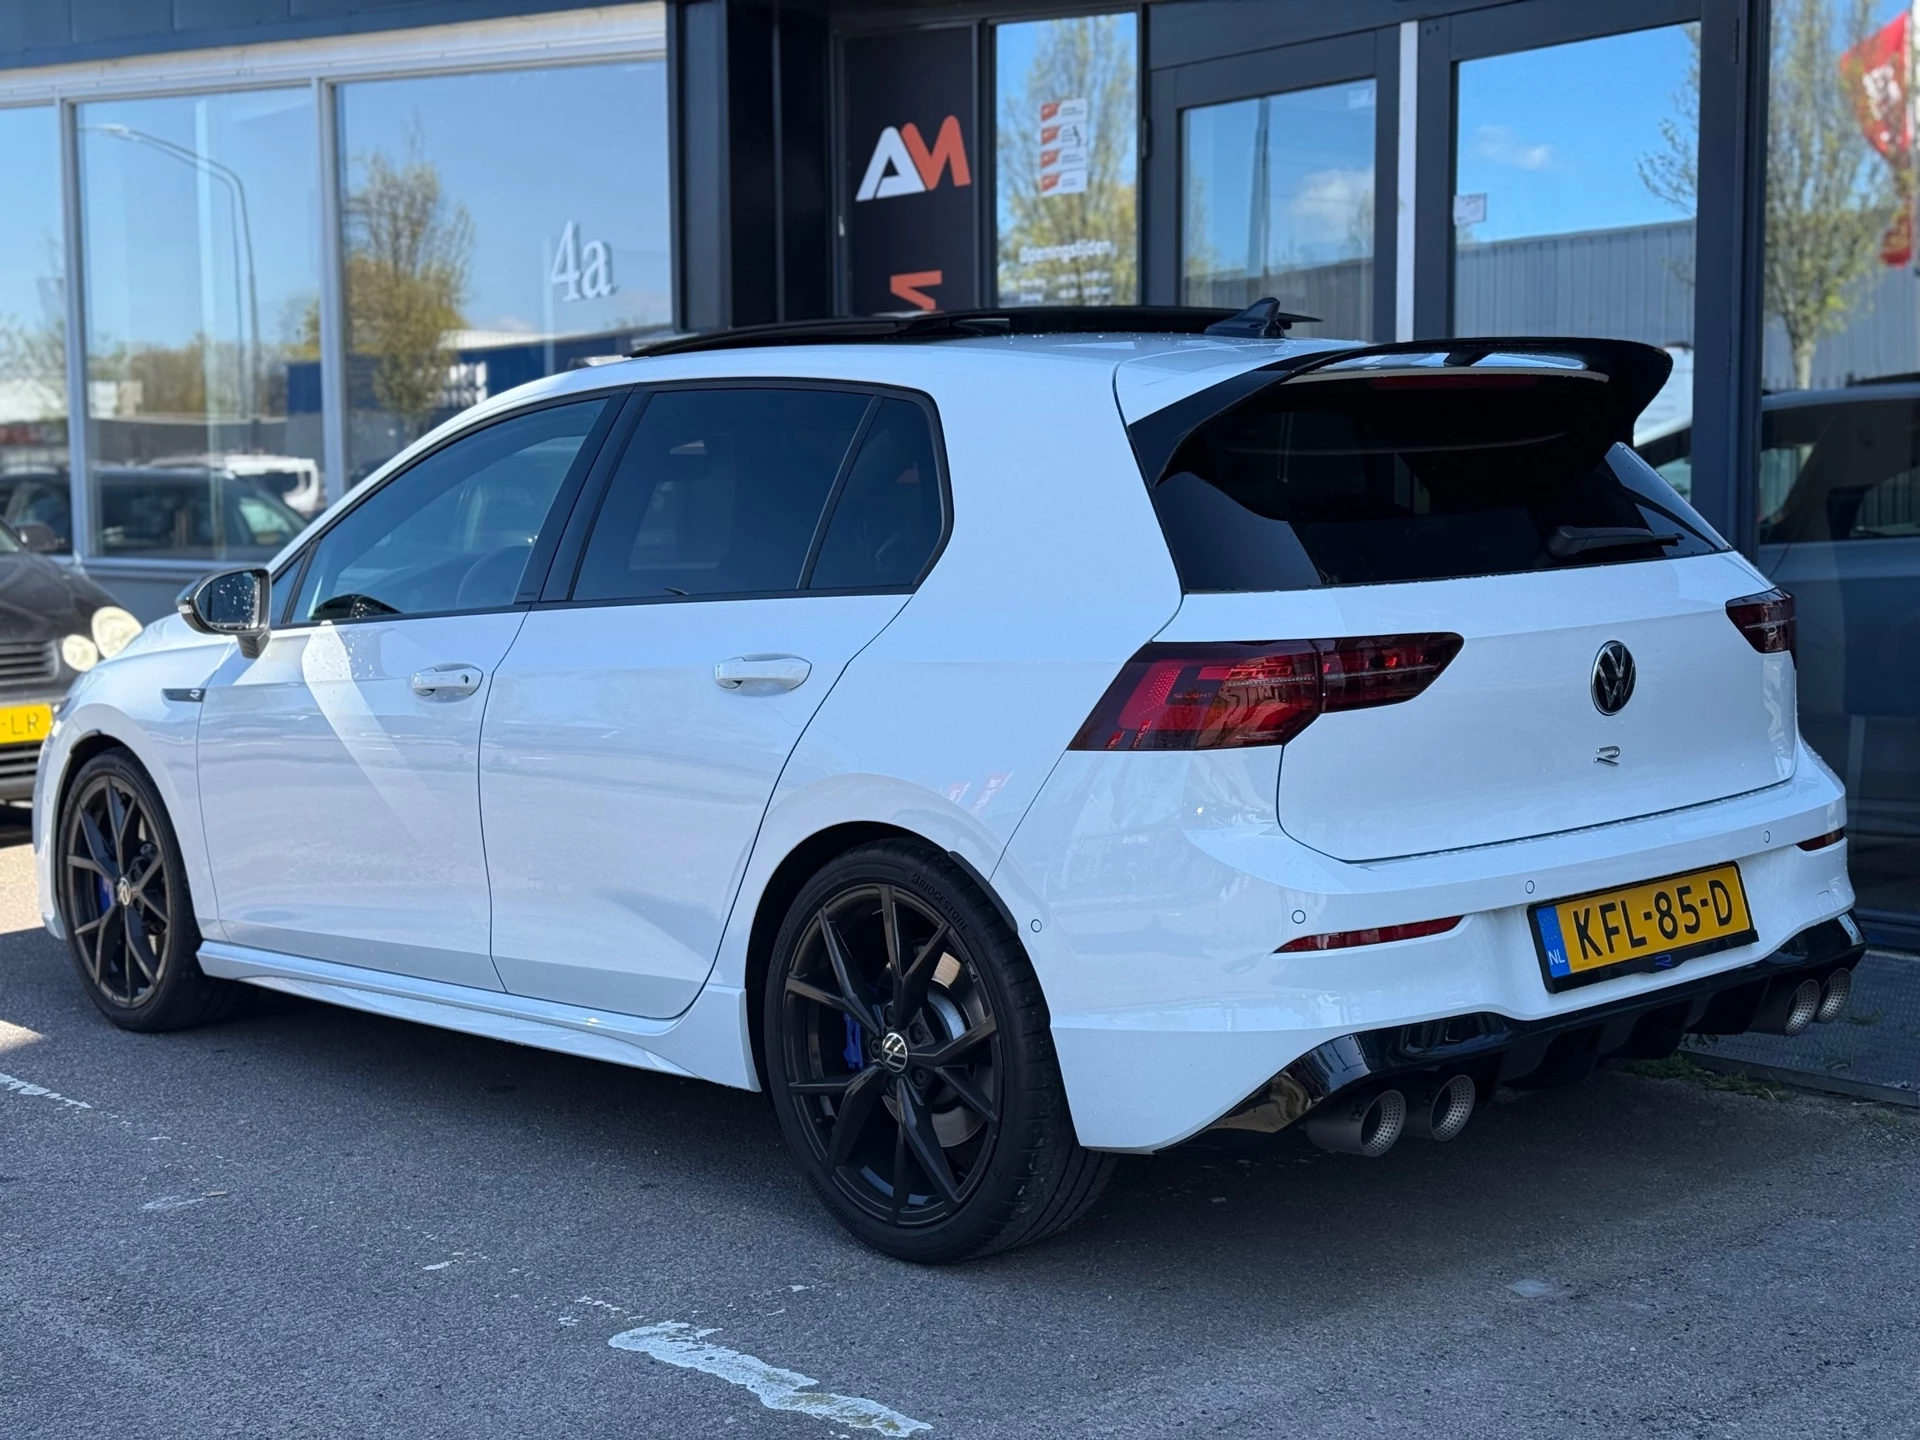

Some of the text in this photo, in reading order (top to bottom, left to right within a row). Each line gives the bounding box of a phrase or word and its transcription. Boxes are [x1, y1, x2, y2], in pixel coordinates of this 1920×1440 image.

[855, 115, 971, 202] AM
[551, 220, 612, 301] 4a
[1593, 745, 1620, 767] R
[911, 873, 970, 934] BRIDGESTONE
[1572, 879, 1733, 960] KFL-85-D
[1548, 951, 1566, 966] NL
